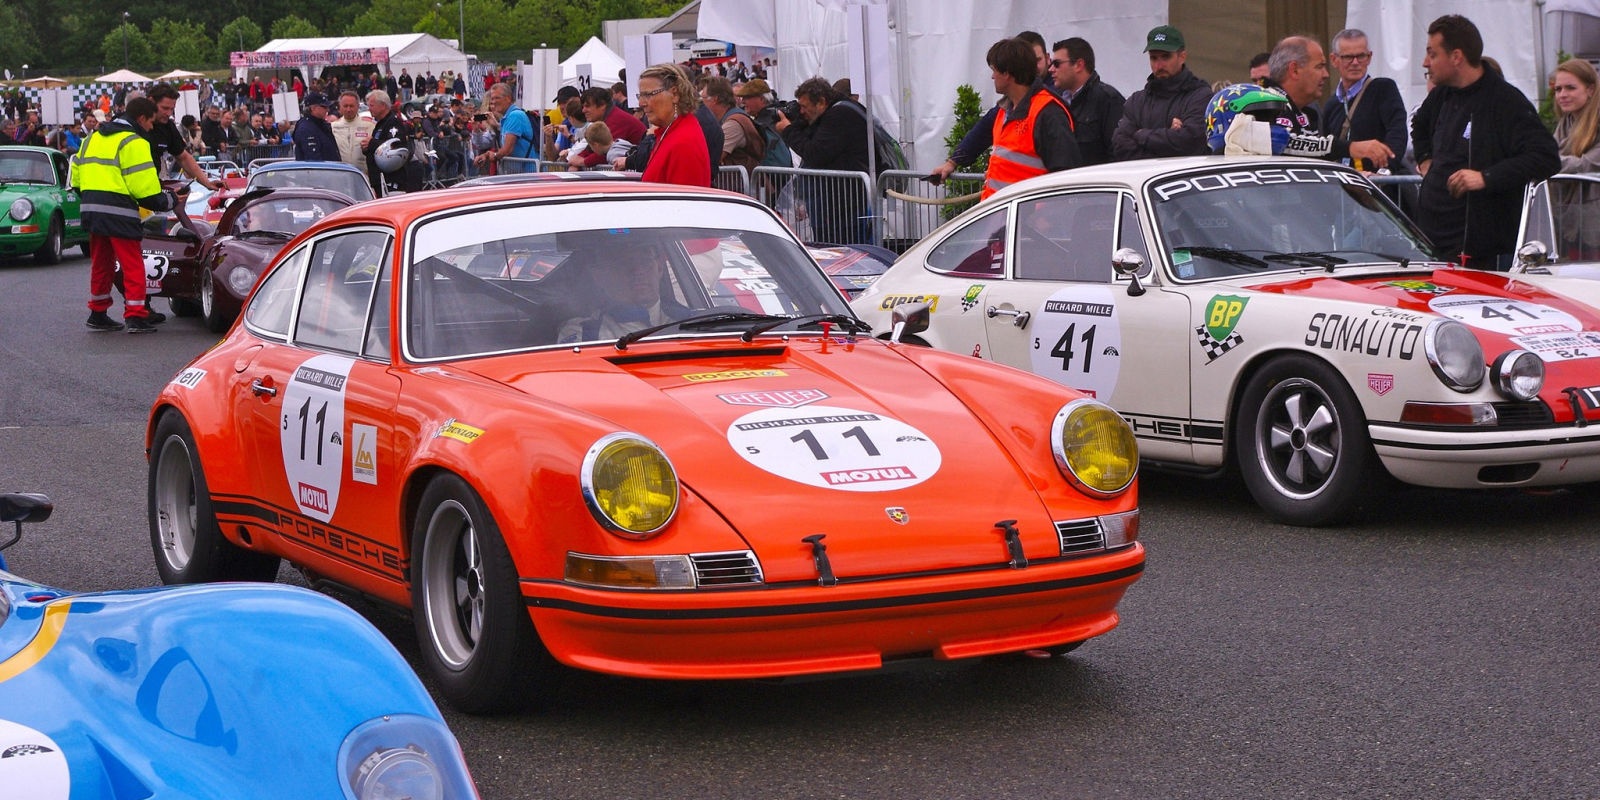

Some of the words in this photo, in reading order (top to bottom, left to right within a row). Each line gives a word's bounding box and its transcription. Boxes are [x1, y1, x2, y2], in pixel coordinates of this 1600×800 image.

[578, 74, 591, 94] 31
[1154, 168, 1374, 201] PORSCHE
[967, 286, 983, 298] BP
[1046, 302, 1083, 312] RICHARD
[1085, 305, 1112, 315] MILLE
[1208, 300, 1243, 328] BP
[1482, 304, 1540, 321] 41
[1305, 312, 1423, 360] SONAUTO
[1034, 337, 1041, 350] 5
[1050, 322, 1097, 374] 41
[1556, 349, 1588, 358] 84
[296, 368, 324, 383] RICHARD
[324, 375, 343, 388] MILLE
[687, 370, 758, 382] BOSCH
[1370, 379, 1392, 394] HEUER
[728, 390, 818, 407] HEUER
[283, 414, 288, 430] 5
[298, 396, 329, 465] 11
[741, 417, 816, 430] RICHARD
[824, 414, 874, 424] MILLE
[448, 426, 479, 440] DUNLOP
[746, 446, 760, 455] 5
[790, 425, 881, 460] 11
[829, 467, 912, 484] MOTUL
[300, 487, 328, 511] MOTUL
[280, 514, 401, 571] PORSCHE
